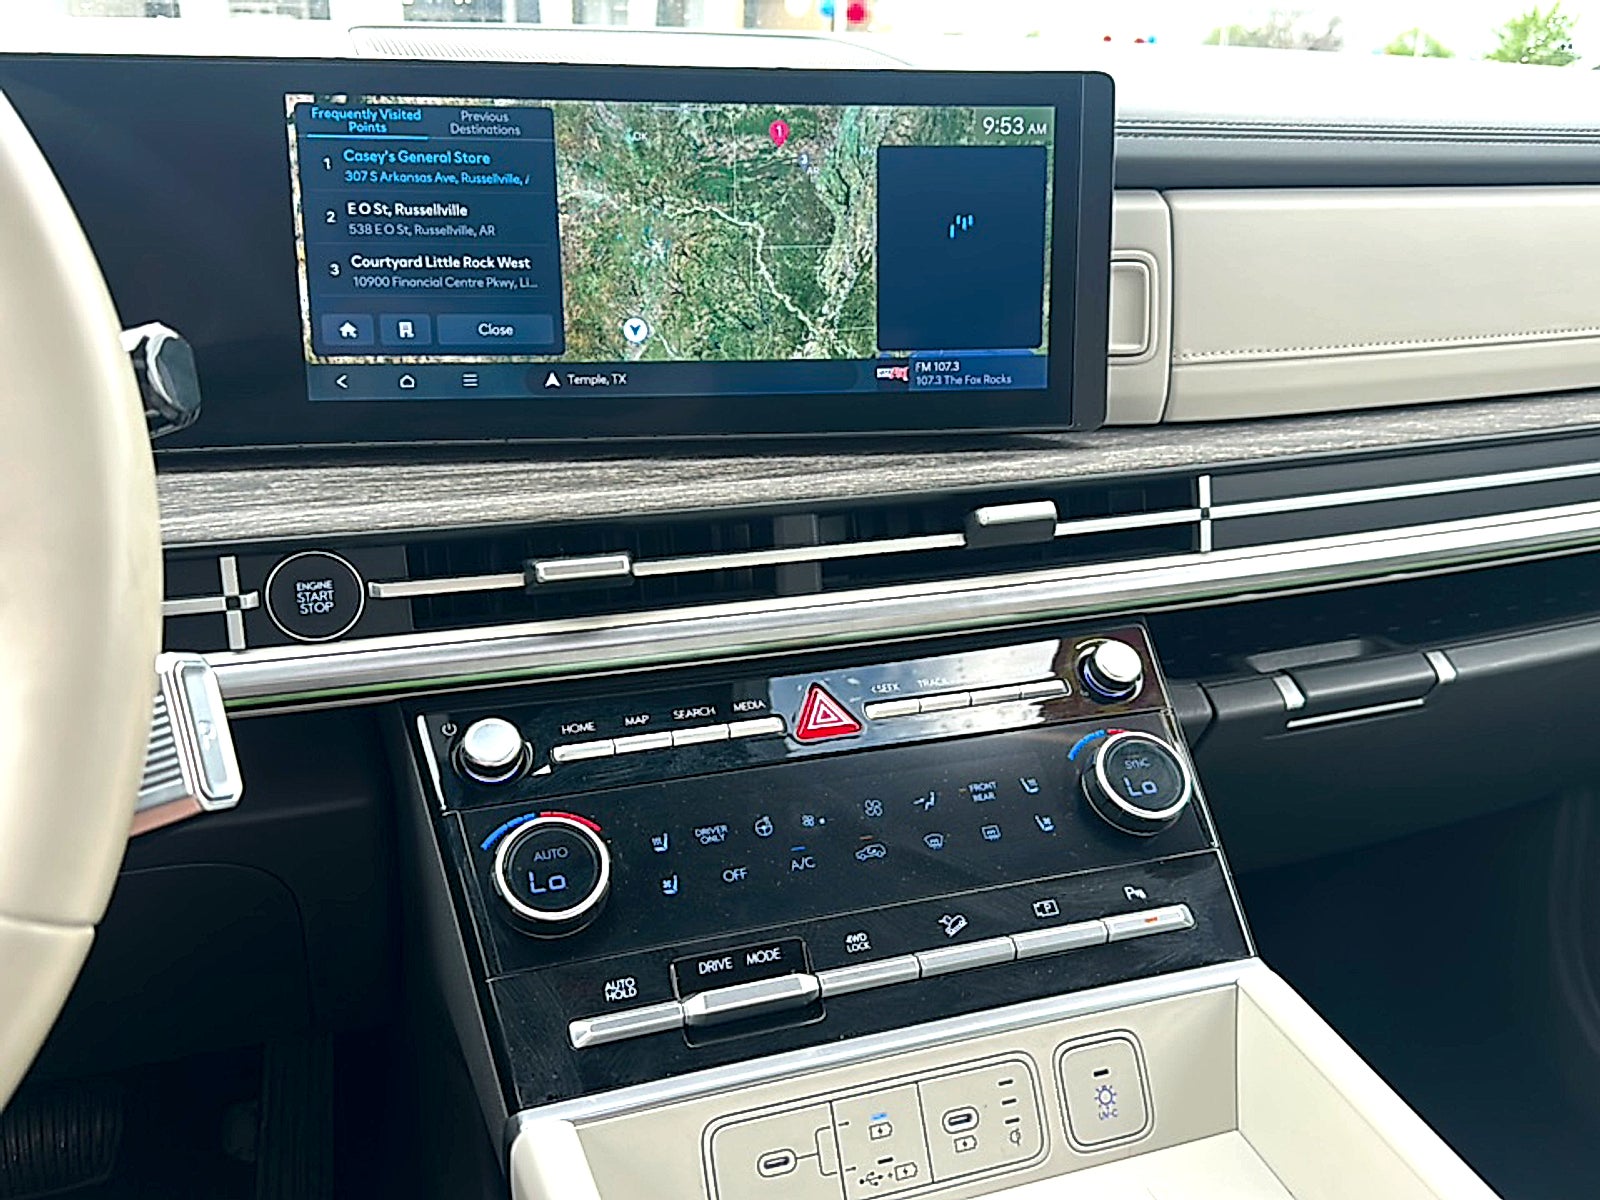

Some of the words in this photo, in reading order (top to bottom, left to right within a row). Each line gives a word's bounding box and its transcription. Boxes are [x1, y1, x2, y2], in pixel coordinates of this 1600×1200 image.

[311, 107, 377, 122] Frequently
[379, 108, 421, 122] Visited
[461, 110, 509, 122] Previous
[349, 122, 387, 133] Points
[449, 124, 521, 136] Destinations
[982, 116, 1025, 135] 9:53
[1027, 123, 1047, 134] AM
[323, 158, 331, 170] 1
[343, 150, 396, 164] Casey's
[397, 150, 451, 164] General
[454, 152, 491, 165] Store
[344, 170, 367, 182] 307
[369, 171, 377, 182] S
[379, 171, 433, 183] Arkansas
[434, 173, 458, 184] Ave,
[461, 173, 523, 185] Russellville,
[347, 202, 357, 216] E
[358, 203, 371, 216] O
[373, 203, 392, 217] St,
[394, 204, 468, 217] Russellville
[326, 211, 337, 223] 2
[349, 224, 373, 236] 538
[375, 225, 382, 236] E
[383, 226, 395, 236] O
[396, 226, 413, 237] St,
[415, 226, 477, 238] Russellville,
[479, 226, 496, 237] AR
[350, 255, 423, 270] Courtyard
[425, 257, 461, 269] Little
[463, 258, 495, 270] Rock
[497, 258, 532, 270] West
[329, 264, 341, 276] 3
[353, 276, 391, 288] 10900
[392, 277, 443, 289] Financial
[445, 277, 484, 289] Centre
[486, 278, 518, 290] Pkwy,
[478, 323, 514, 336] Close
[915, 362, 932, 372] FM
[934, 361, 960, 372] 107.3
[567, 374, 609, 387] Temple,
[610, 374, 627, 385] TX
[916, 375, 943, 386] 107.3
[944, 374, 963, 386] The
[964, 374, 982, 385] Fox
[983, 374, 1012, 385] Rocks
[296, 580, 333, 591] ENGINE
[296, 590, 334, 603] START
[300, 602, 334, 614] STOP
[733, 699, 766, 712] MEDIA
[673, 706, 716, 720] SEARCH
[625, 715, 649, 726] MAP
[561, 721, 596, 735] HOME
[694, 824, 728, 838] DRIVER
[533, 846, 568, 862] AUTO
[791, 856, 815, 871] A/C
[722, 868, 748, 883] OFF
[846, 941, 871, 953] LOCK
[699, 957, 733, 975] DRIVE
[746, 947, 782, 966] MODE
[604, 977, 635, 991] AUTO
[605, 987, 637, 1001] HOLD
